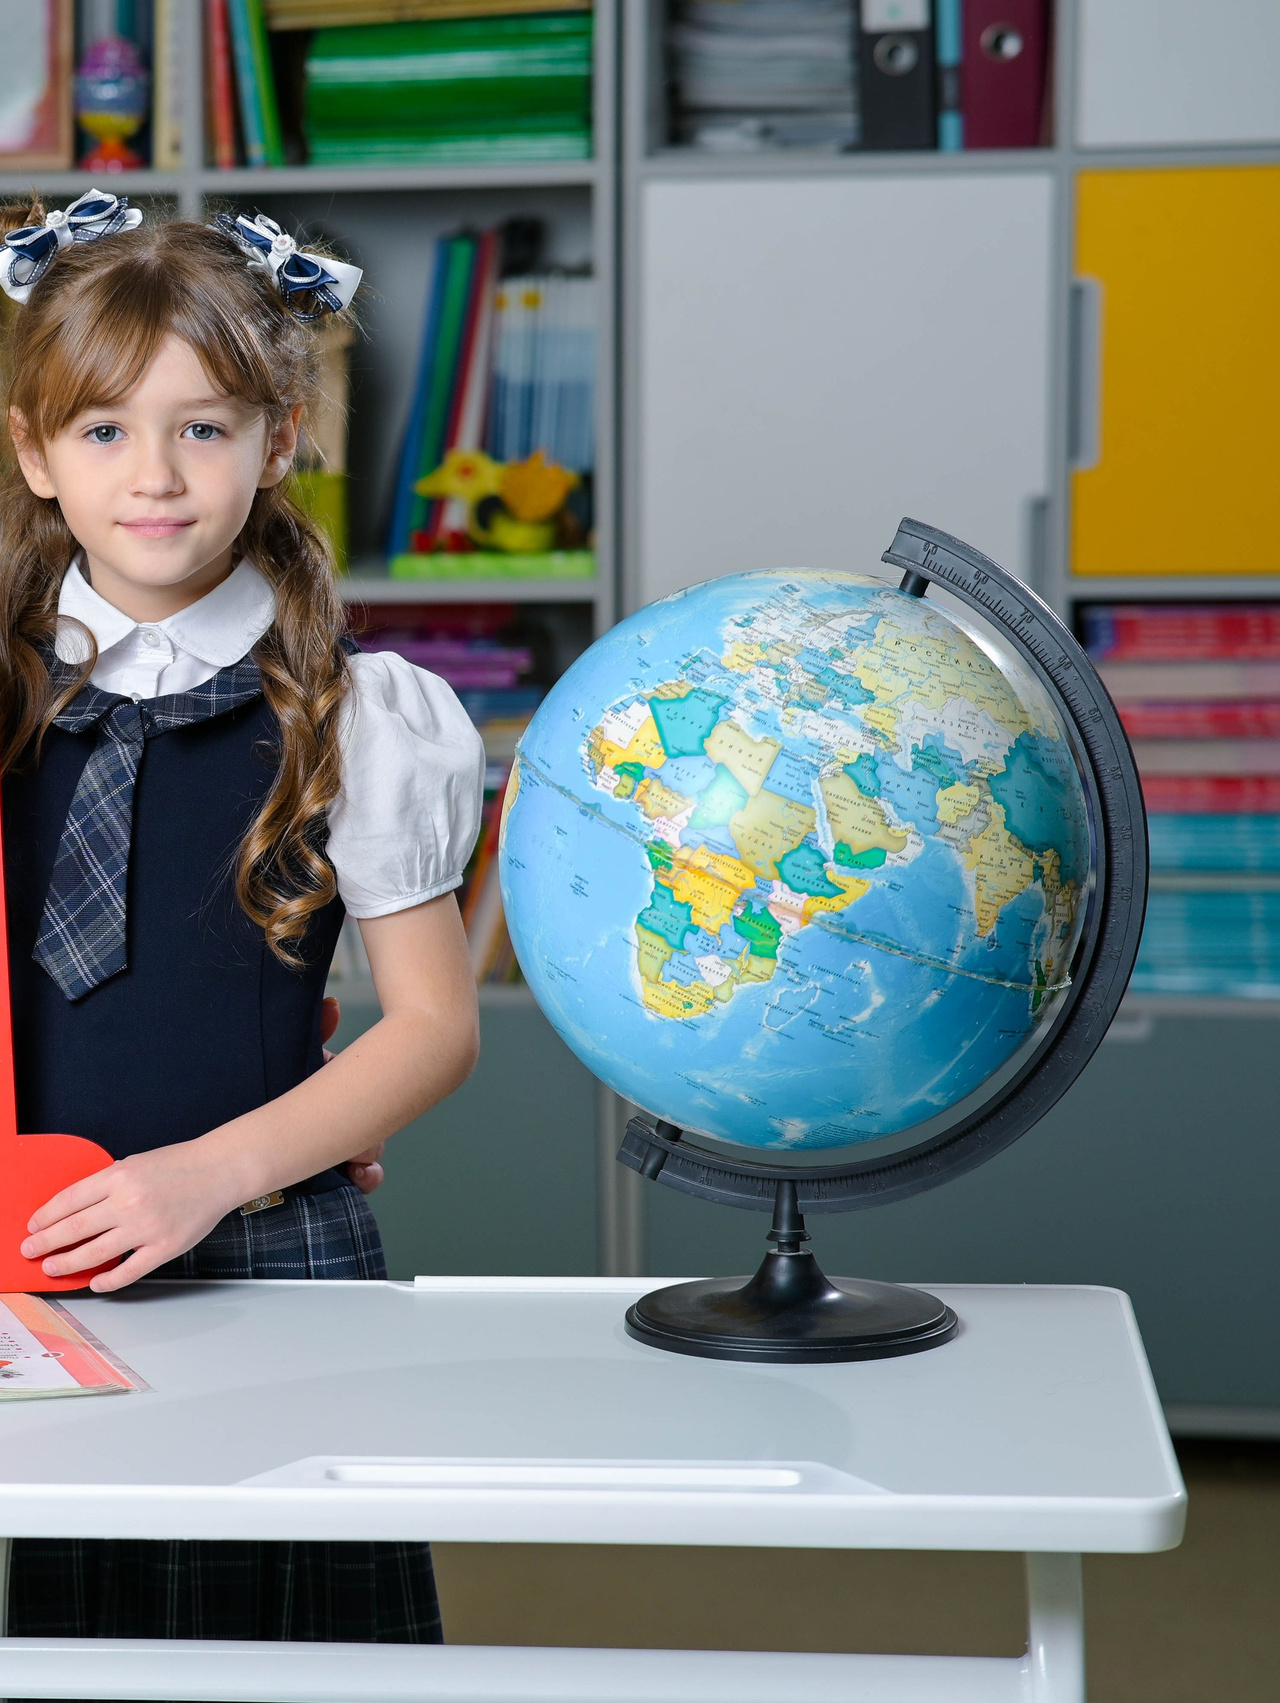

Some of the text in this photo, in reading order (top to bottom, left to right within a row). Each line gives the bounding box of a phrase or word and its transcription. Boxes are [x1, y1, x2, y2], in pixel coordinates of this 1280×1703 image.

[922, 542, 938, 555] 90
[974, 571, 990, 585] 80
[1019, 608, 1034, 624] 70
[933, 717, 999, 738] КАЗАХСТАН
[827, 732, 864, 749] ТУРЦИЯ
[719, 740, 763, 762] ЛИВИЯ
[767, 777, 800, 792] ЕГИПЕТ
[886, 781, 921, 795] ИРАН
[826, 791, 861, 807] САУДОВСКАЯ
[851, 826, 872, 835] АРАВИЯ
[740, 832, 772, 849] СУДАН
[649, 913, 679, 931] АНГОЛА
[669, 962, 697, 978] БОТСВАНА
[652, 993, 686, 1013] РЕСПУБЛИКА
